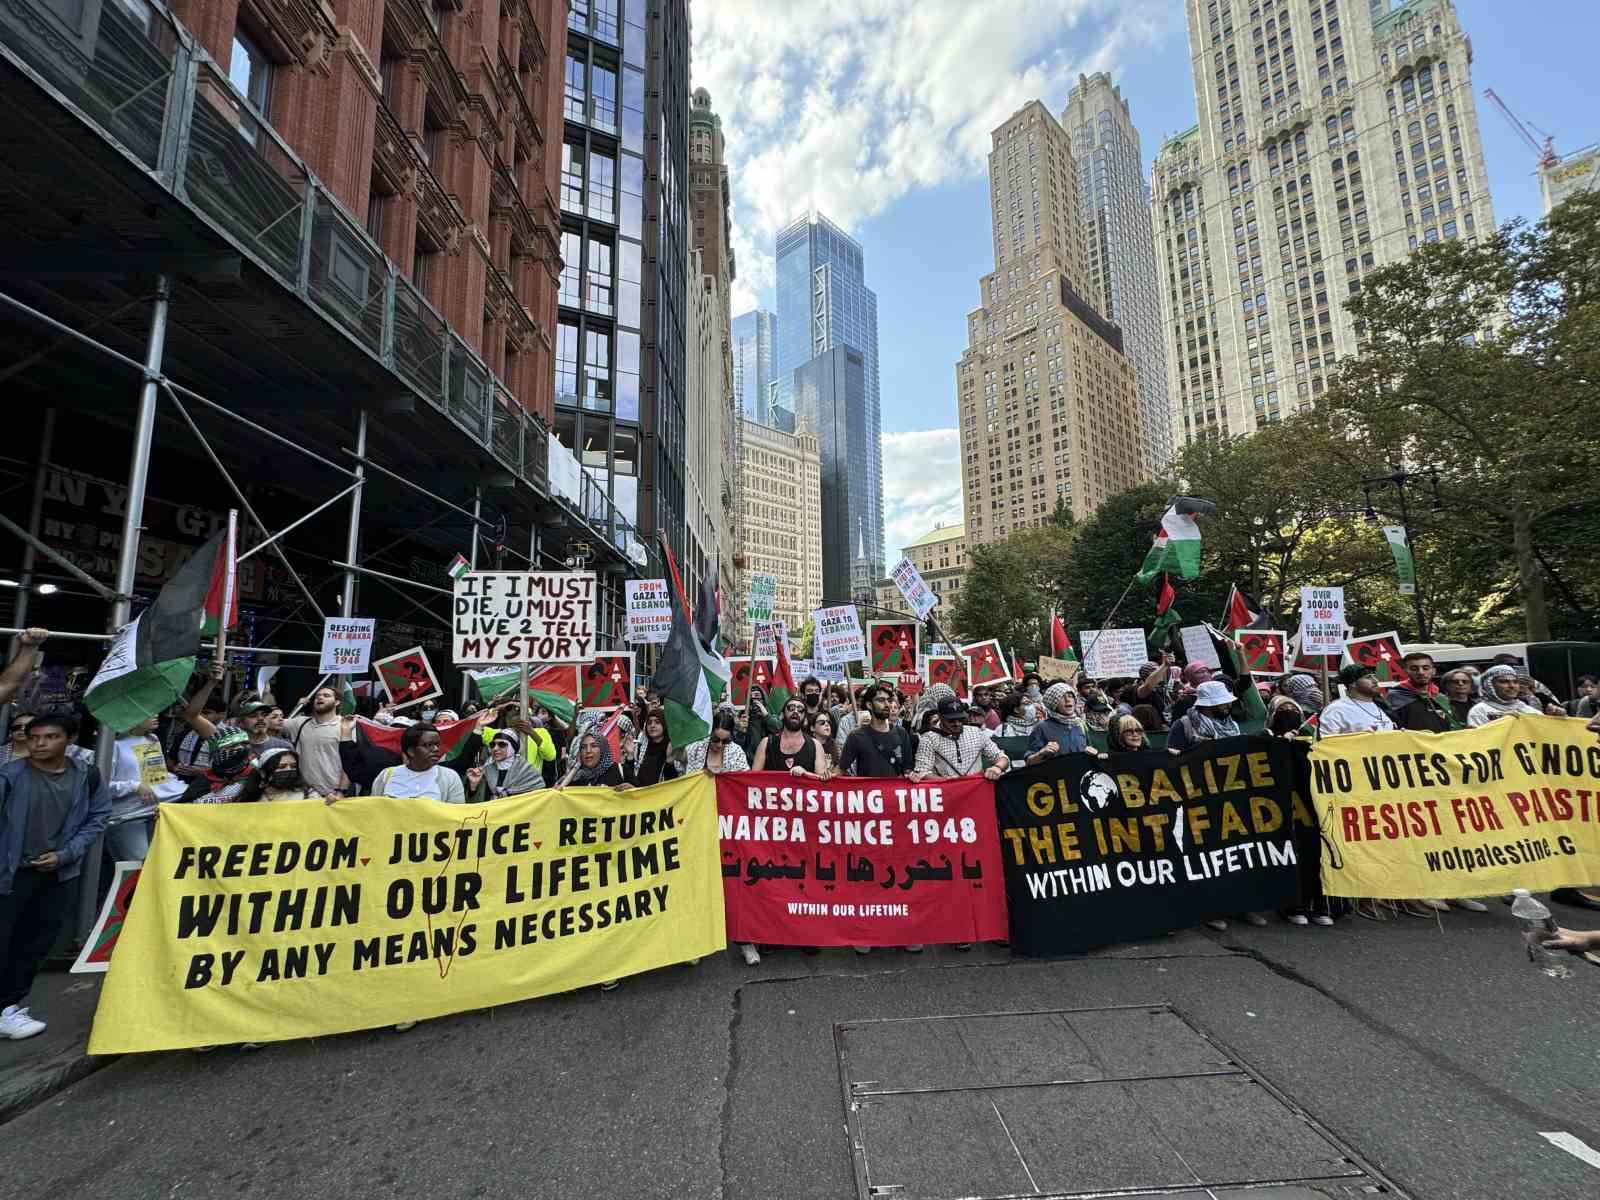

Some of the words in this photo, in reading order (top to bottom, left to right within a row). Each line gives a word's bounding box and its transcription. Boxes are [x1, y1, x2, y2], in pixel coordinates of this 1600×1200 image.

[462, 576, 497, 597] IF
[505, 576, 521, 598] I
[527, 576, 594, 600] MUST
[632, 592, 656, 601] GAZA
[658, 591, 669, 600] TO
[639, 582, 662, 591] FROM
[1312, 590, 1331, 600] OVER
[505, 600, 523, 619] U
[526, 600, 593, 620] MUST
[329, 624, 371, 633] RESISTING
[455, 617, 511, 636] LIVE
[520, 619, 533, 635] 2
[541, 621, 593, 638] TELL
[820, 616, 841, 627] GAZA
[327, 631, 343, 640] THE
[333, 647, 361, 657] SINCE
[461, 637, 500, 660] MY
[503, 635, 592, 661] STORY
[335, 655, 360, 665] 1948
[899, 673, 920, 684] STOP
[1313, 758, 1353, 795] NO
[1362, 752, 1451, 791] VOTES
[1455, 748, 1505, 785] FOR
[747, 786, 885, 815] RESISTING
[894, 787, 945, 814] THE
[1341, 799, 1443, 843] RESIST
[1450, 795, 1505, 835] FOR
[719, 815, 807, 843] NAKBA
[817, 819, 895, 846] SINCE
[906, 816, 978, 845] 1948
[1003, 821, 1083, 867] THE
[177, 883, 362, 940] WITHIN
[386, 871, 483, 921] OUR
[504, 836, 681, 905] LIFETIME
[1025, 862, 1112, 900] WITHIN
[1116, 858, 1177, 889] OUR
[787, 902, 829, 917] WITHIN
[832, 903, 856, 917] OUR
[859, 901, 910, 918] LIFETIME
[184, 949, 246, 990] BY
[256, 942, 337, 983] ANY
[352, 924, 478, 971] MEANS
[493, 884, 670, 951] NECESSARY
